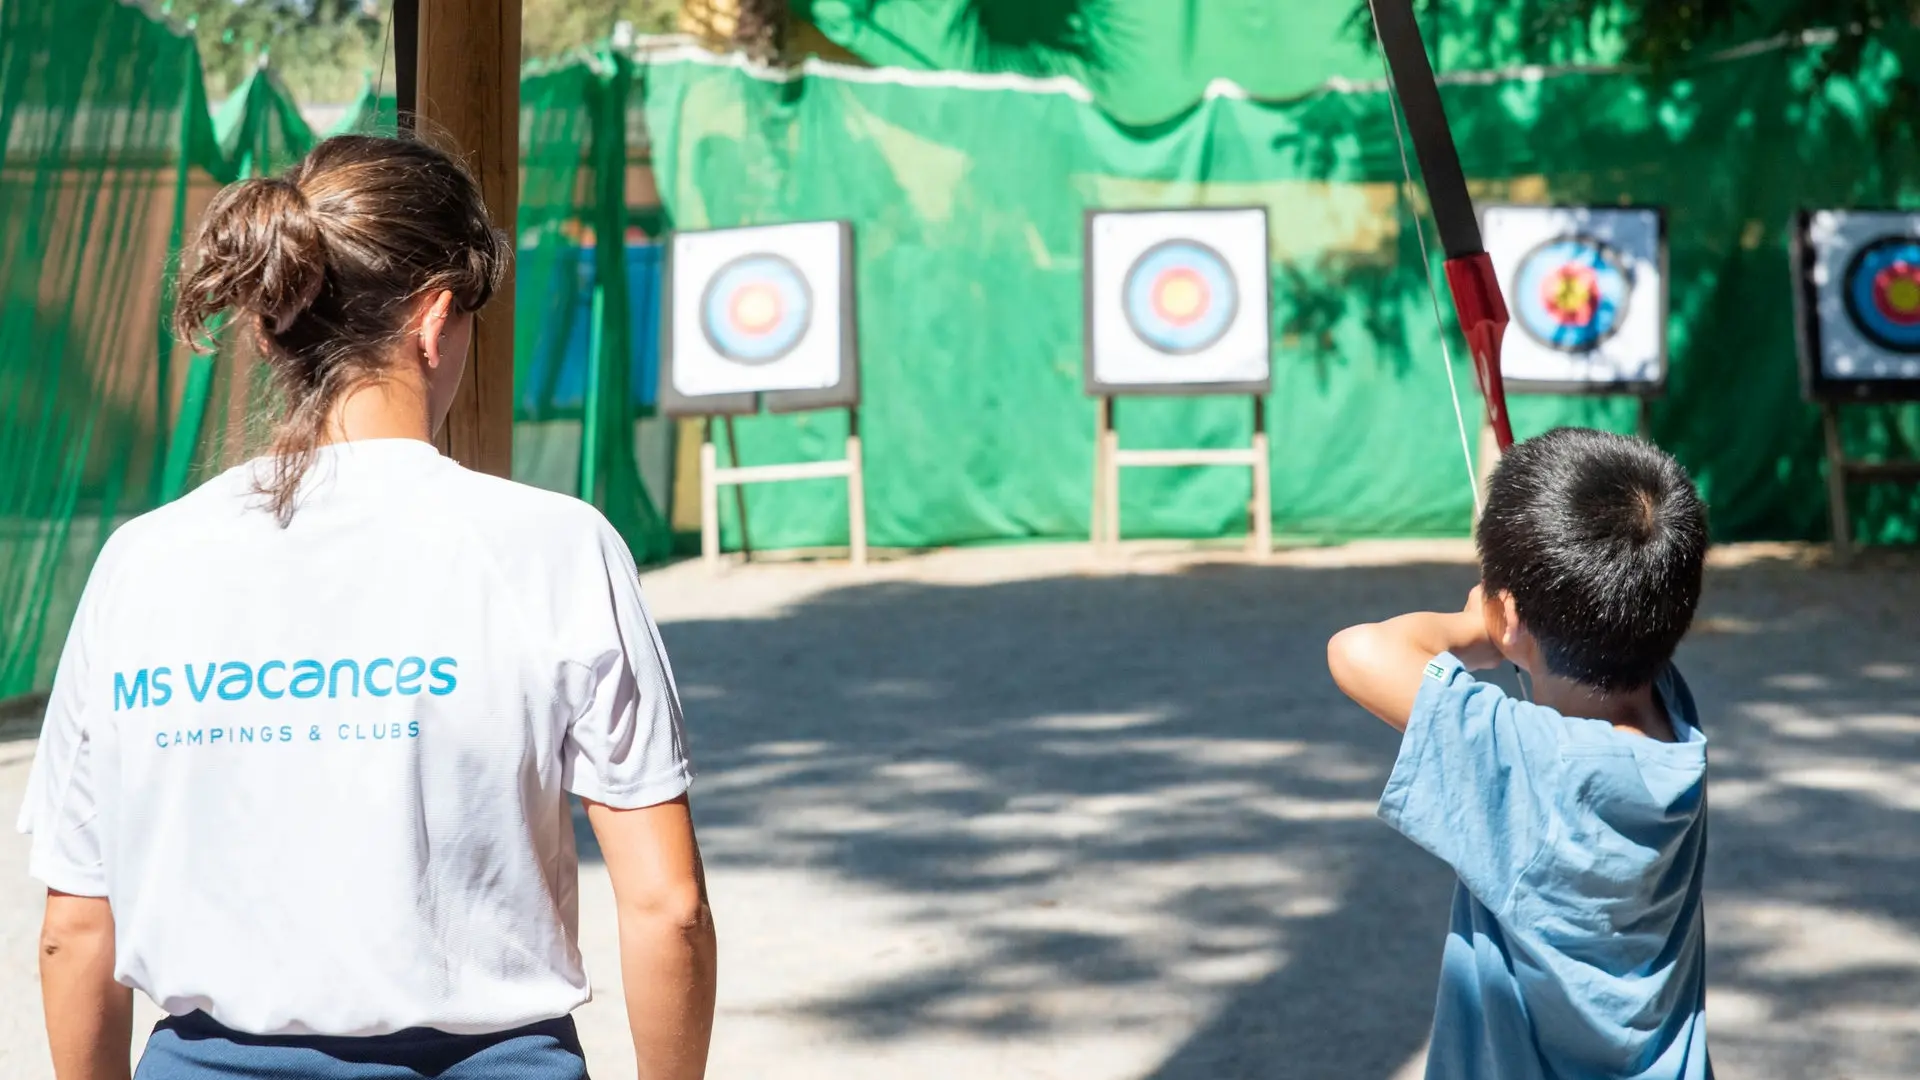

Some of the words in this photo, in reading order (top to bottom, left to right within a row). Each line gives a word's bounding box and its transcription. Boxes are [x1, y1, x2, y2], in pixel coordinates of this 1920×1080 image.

[113, 666, 173, 711] MS
[156, 725, 293, 748] CAMPINGS
[309, 727, 322, 741] &
[338, 720, 420, 741] CLUBS
